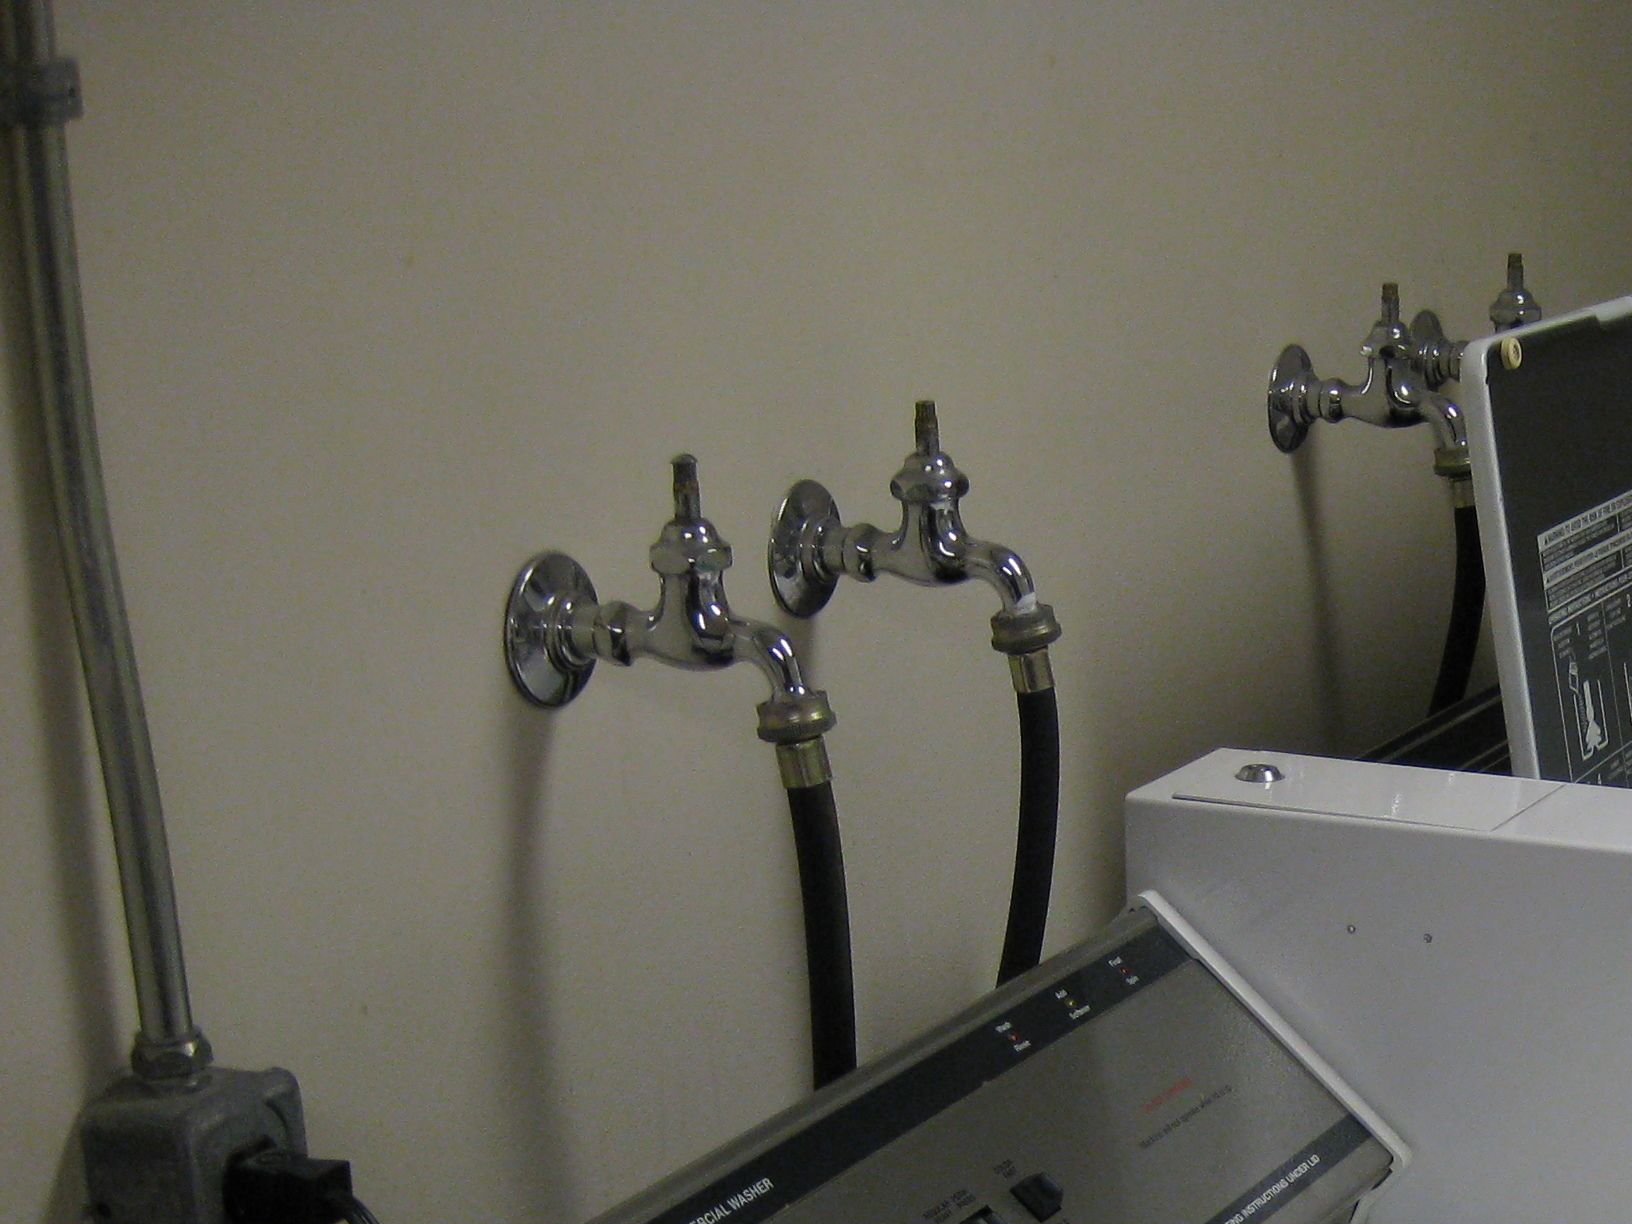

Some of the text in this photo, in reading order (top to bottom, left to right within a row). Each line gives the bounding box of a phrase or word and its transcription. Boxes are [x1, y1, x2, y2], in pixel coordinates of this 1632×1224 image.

[1626, 593, 1632, 608] 2
[727, 1177, 775, 1211] WASHER
[1241, 1177, 1289, 1218] INSTRUCTIONS
[1285, 1161, 1311, 1183] UNDER
[1306, 1154, 1321, 1167] LID
